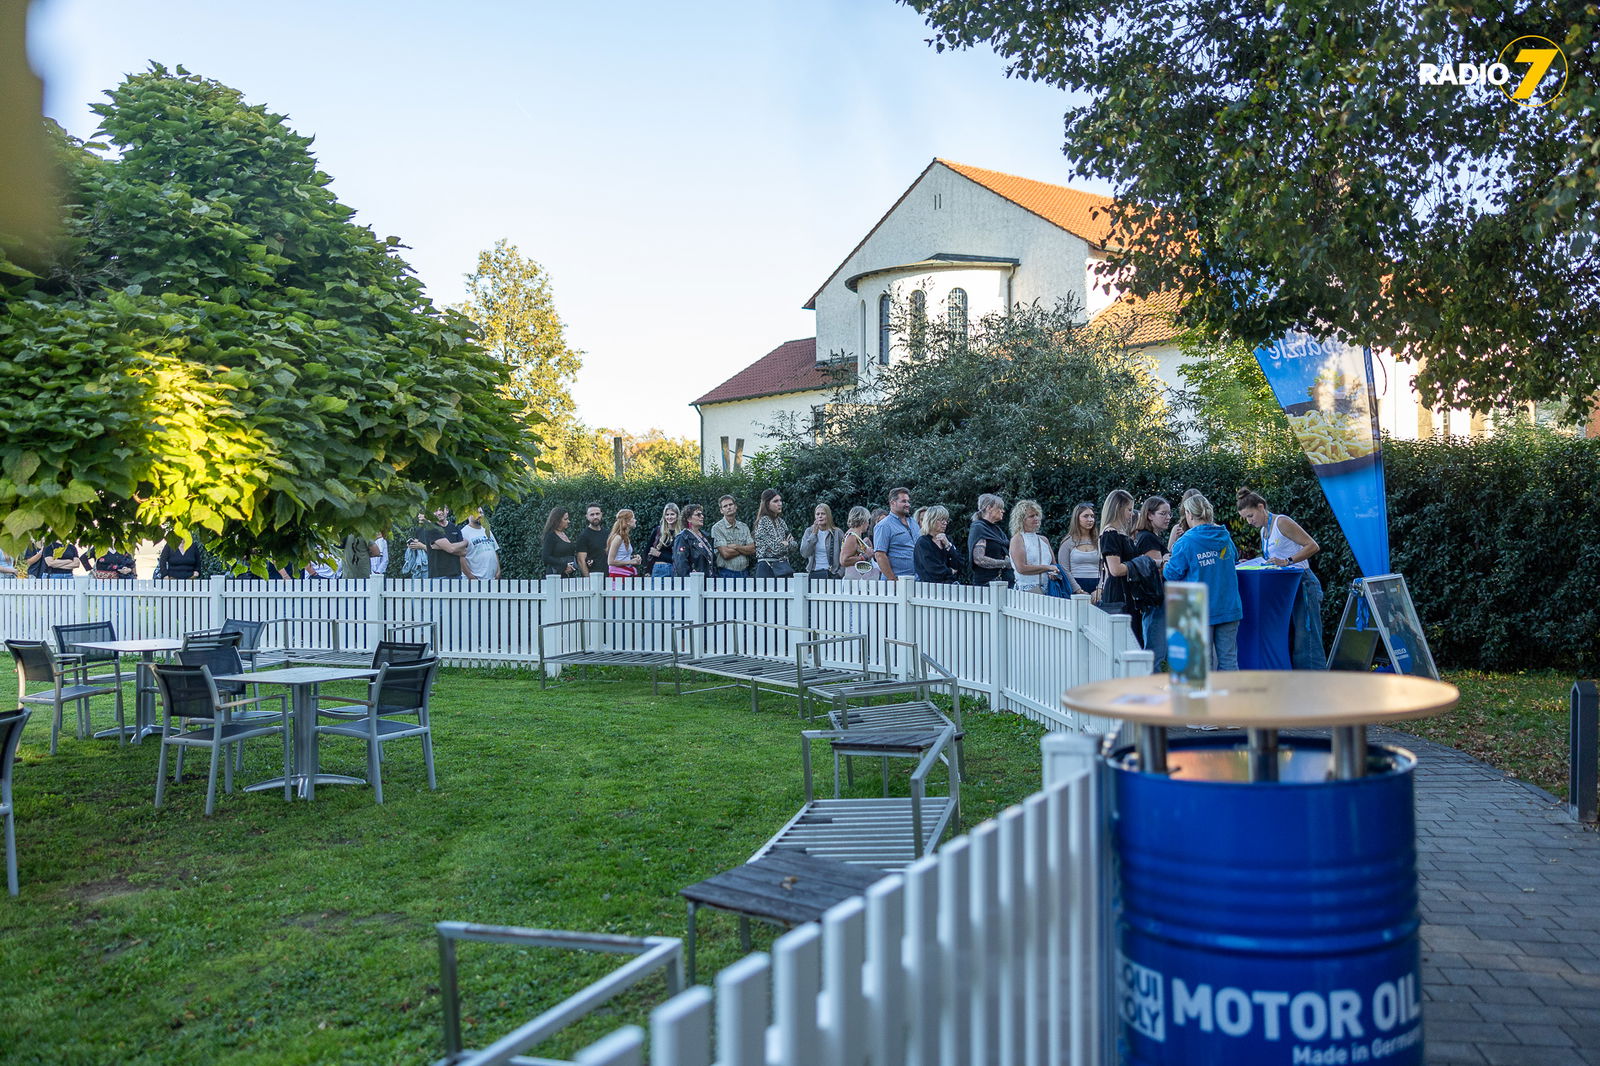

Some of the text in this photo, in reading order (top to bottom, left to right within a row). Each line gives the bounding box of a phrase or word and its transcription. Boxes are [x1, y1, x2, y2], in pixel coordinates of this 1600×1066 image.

[1197, 551, 1218, 560] RADIO
[1198, 558, 1215, 567] TEAM
[1122, 961, 1158, 1001] QUI
[1123, 995, 1160, 1033] OLY
[1171, 973, 1421, 1042] MOTOR OIL
[1293, 1043, 1348, 1066] Made
[1351, 1042, 1369, 1063] in
